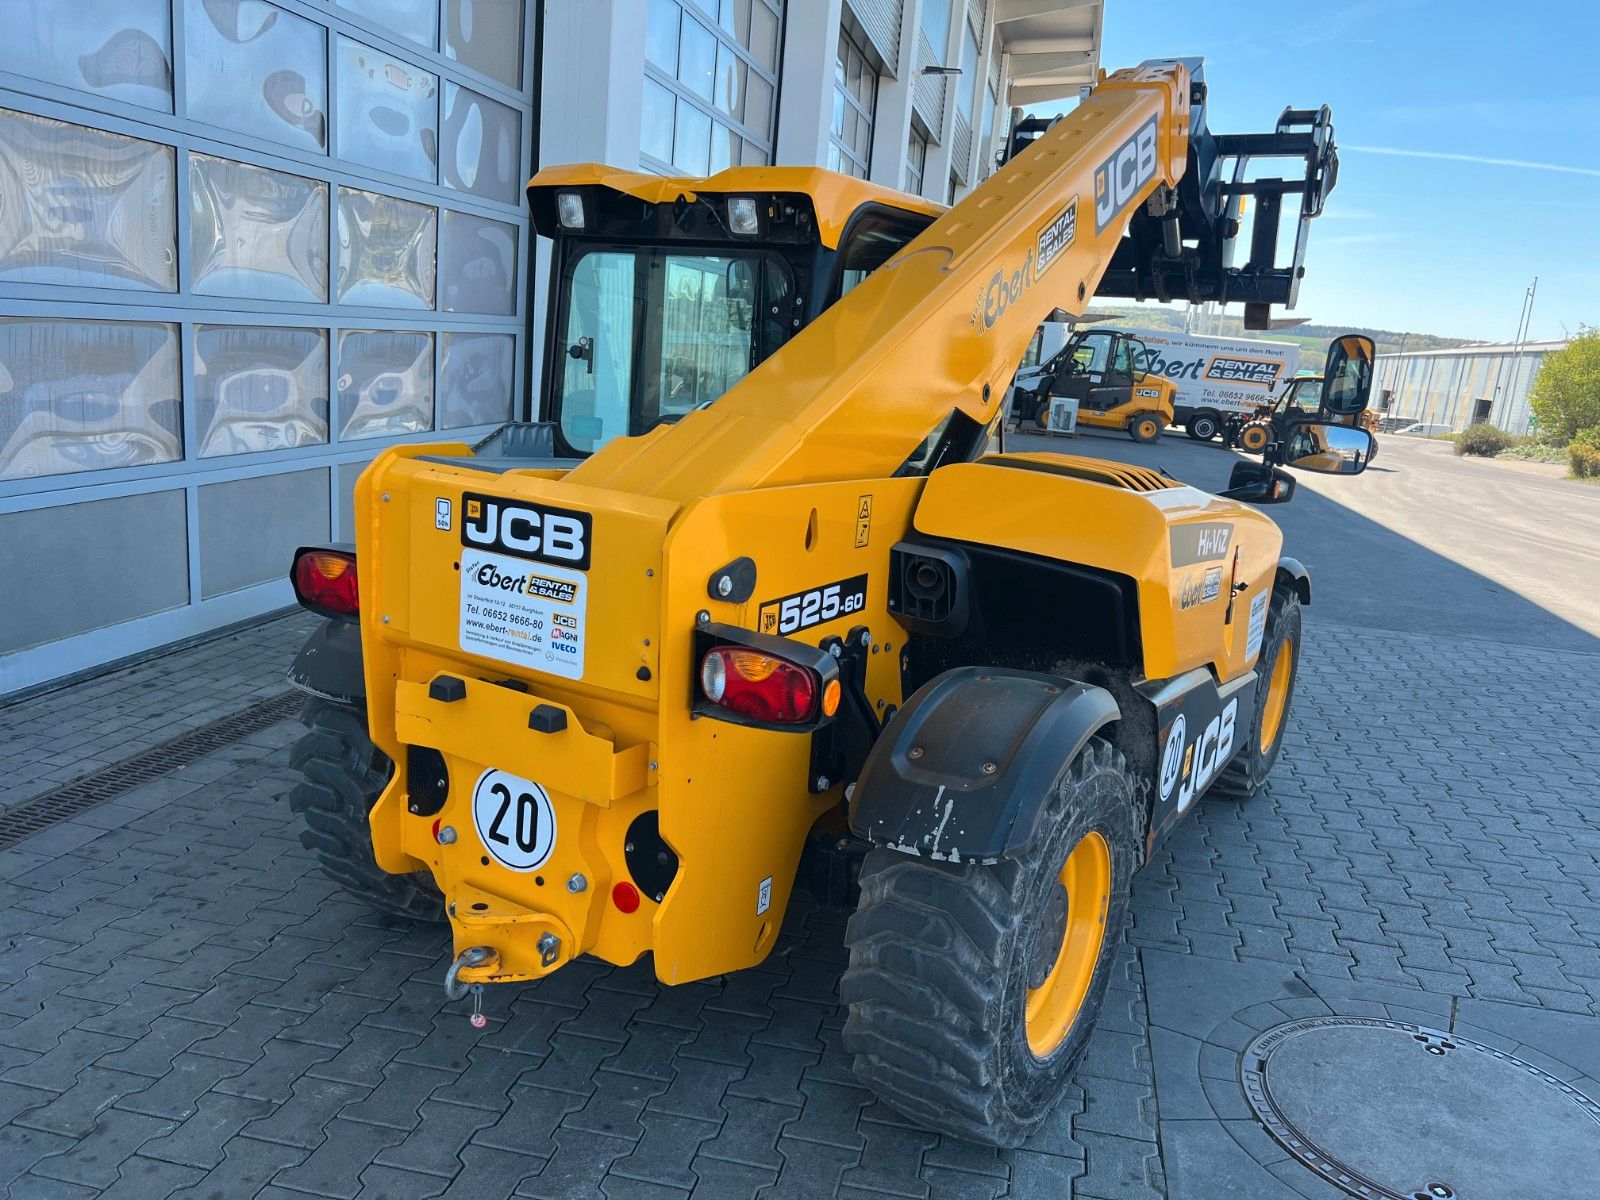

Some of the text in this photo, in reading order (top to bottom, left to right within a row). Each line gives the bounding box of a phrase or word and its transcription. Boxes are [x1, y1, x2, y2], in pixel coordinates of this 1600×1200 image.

[1097, 122, 1156, 226] JCB
[1039, 208, 1075, 251] RENTAL
[1046, 224, 1074, 262] SALES
[984, 248, 1033, 328] Ebert
[1185, 342, 1218, 350] kümmern
[1133, 348, 1205, 380] Ebert
[1213, 359, 1277, 373] RENTAL
[1222, 371, 1274, 384] SALES
[1136, 389, 1159, 397] JCB
[1218, 391, 1244, 399] 06652
[466, 503, 584, 560] JCB
[477, 563, 527, 594] Ebert
[531, 577, 575, 593] RENTAL
[538, 587, 573, 601] SALES
[467, 604, 544, 630] Tel. 06652 9666-80
[554, 613, 577, 628] JCB
[765, 613, 777, 630] JCB
[466, 619, 542, 643] www.ebert-rental.de
[551, 628, 578, 642] MAGNI
[552, 641, 577, 654] IVECO
[1163, 731, 1182, 786] 20
[1178, 697, 1238, 813] JCB
[488, 782, 539, 854] 20
